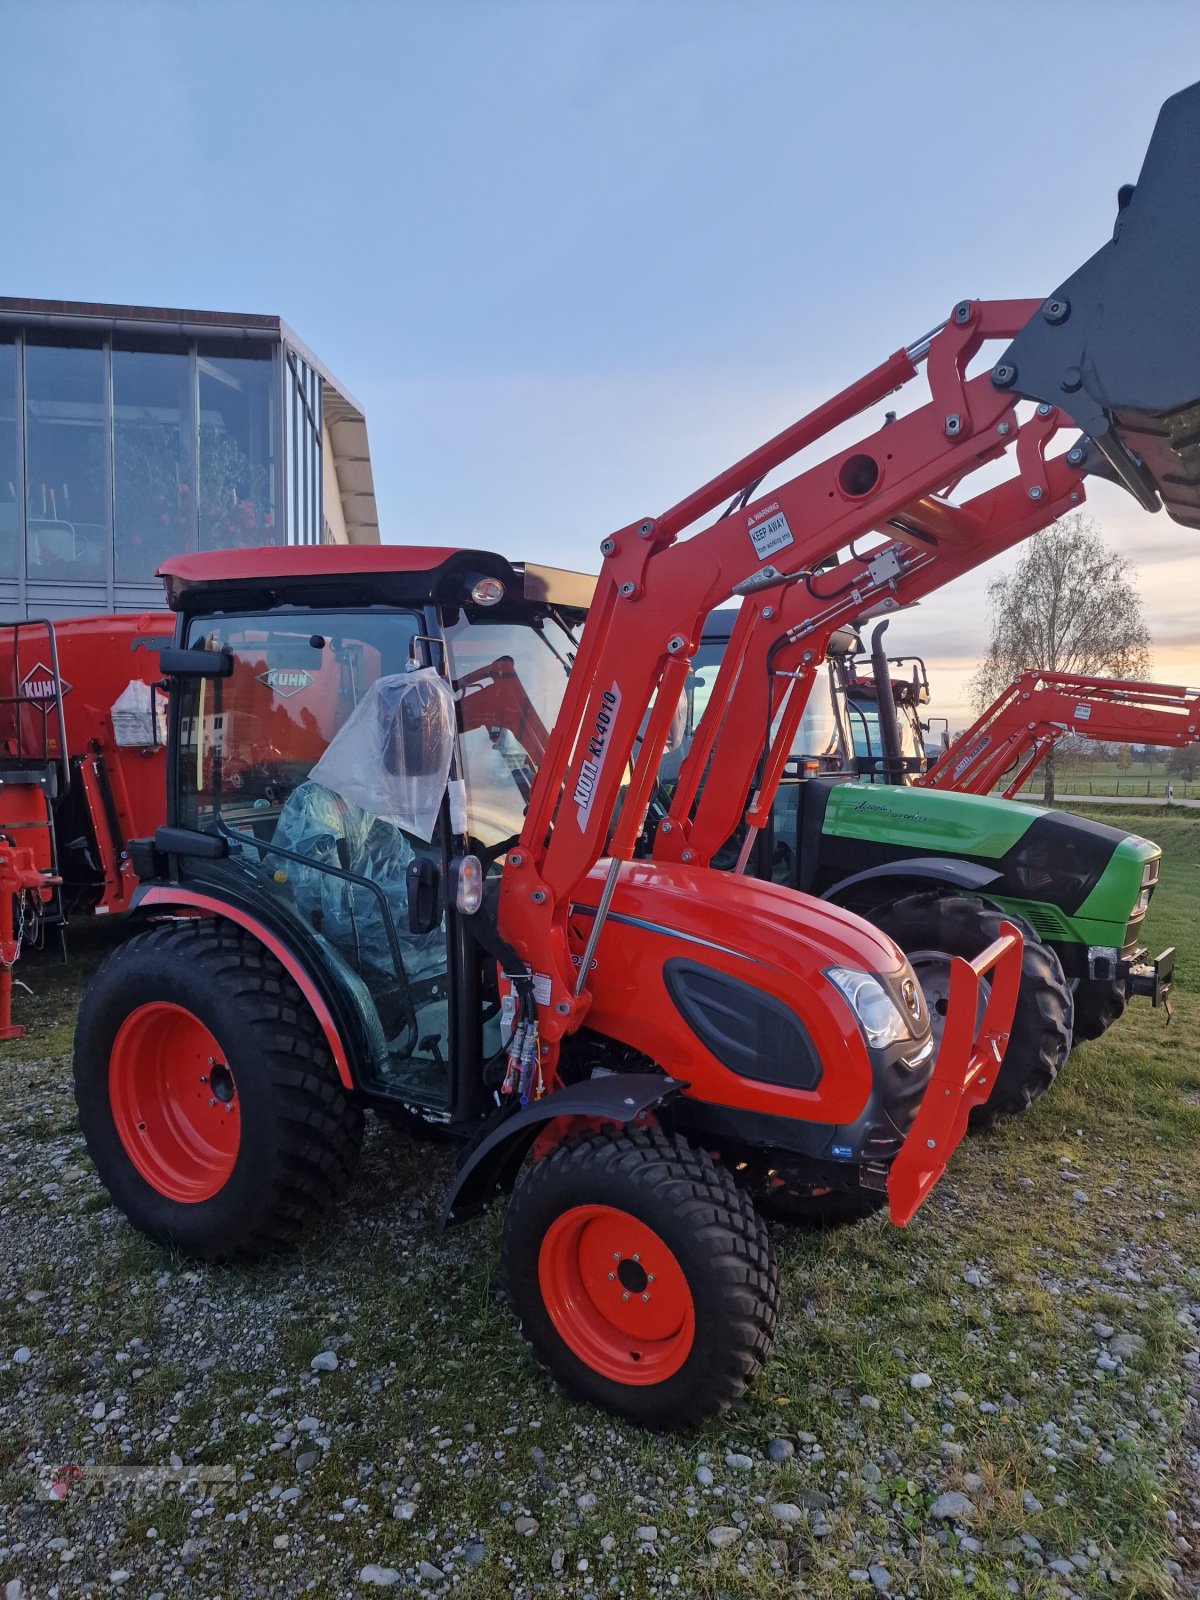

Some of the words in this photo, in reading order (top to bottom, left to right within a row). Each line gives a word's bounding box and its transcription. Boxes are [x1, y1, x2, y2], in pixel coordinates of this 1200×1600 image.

[753, 502, 779, 520] WARNING
[751, 527, 767, 543] KEEP
[768, 516, 785, 534] AWAY
[267, 672, 307, 687] KUHN
[573, 759, 599, 810] KIOTI
[588, 691, 616, 758] KL4010
[955, 756, 971, 774] KIOTI
